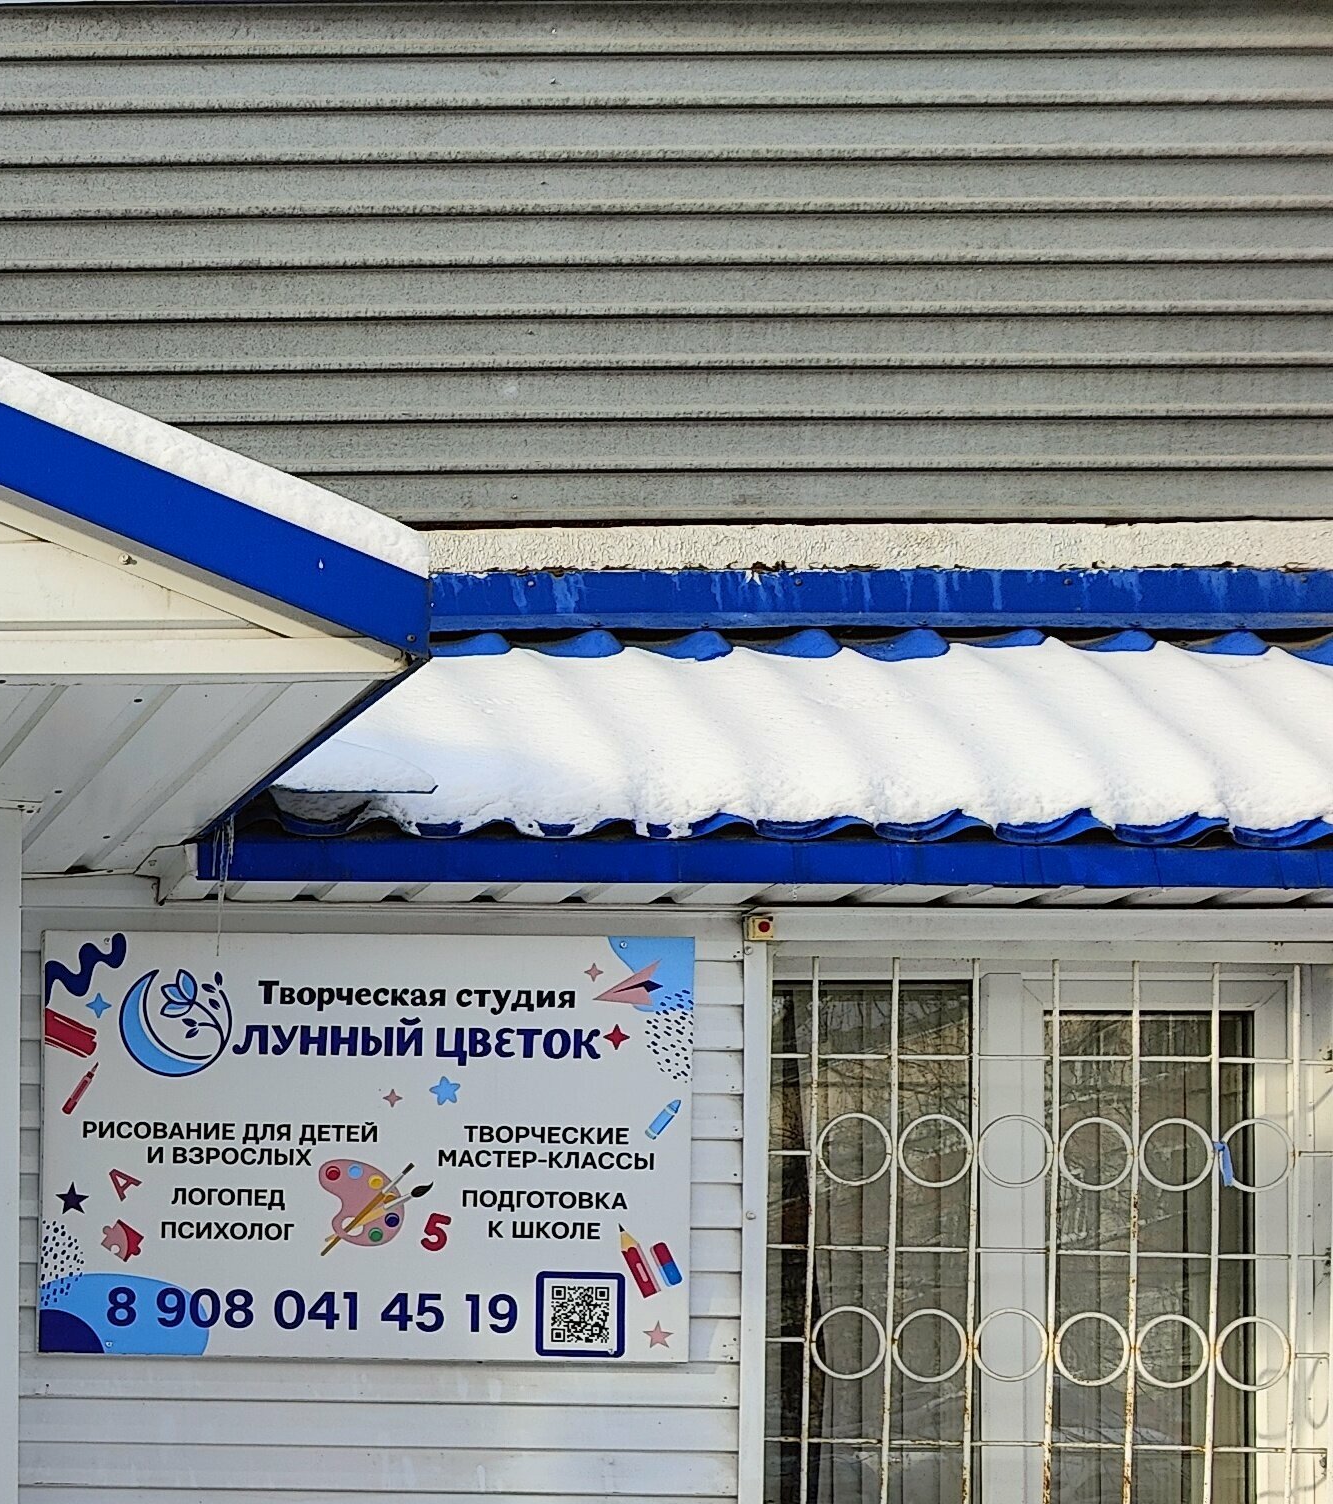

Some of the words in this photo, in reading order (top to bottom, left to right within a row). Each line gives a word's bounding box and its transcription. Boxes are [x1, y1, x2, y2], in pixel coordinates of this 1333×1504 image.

[259, 980, 446, 1012] Творческая
[456, 986, 575, 1015] студия
[231, 1018, 424, 1058] ЛУННЫЙ
[435, 1027, 600, 1066] ЦВЕТОК
[83, 1120, 236, 1141] РИСОВАНИЕ
[242, 1122, 291, 1145] ДЛЯ
[299, 1118, 378, 1146] ДЕТЕЙ
[465, 1125, 628, 1145] ТВОРЧЕСКИЕ
[147, 1147, 164, 1165] И
[172, 1147, 311, 1166] ВЗРОСЛЫХ
[438, 1150, 654, 1170] МАСТЕР-КЛАССЫ
[171, 1187, 285, 1211] ЛОГОПЕД
[462, 1189, 627, 1214] ПОДГОТОВКА
[161, 1220, 294, 1241] ПСИХОЛОГ
[420, 1213, 451, 1252] 5
[488, 1220, 505, 1238] К
[513, 1220, 600, 1240] ШКОЛЕ
[107, 1288, 137, 1327] 8
[156, 1288, 254, 1330] 908
[273, 1292, 359, 1331] 041
[381, 1293, 444, 1332] 45
[465, 1294, 518, 1334] 19
